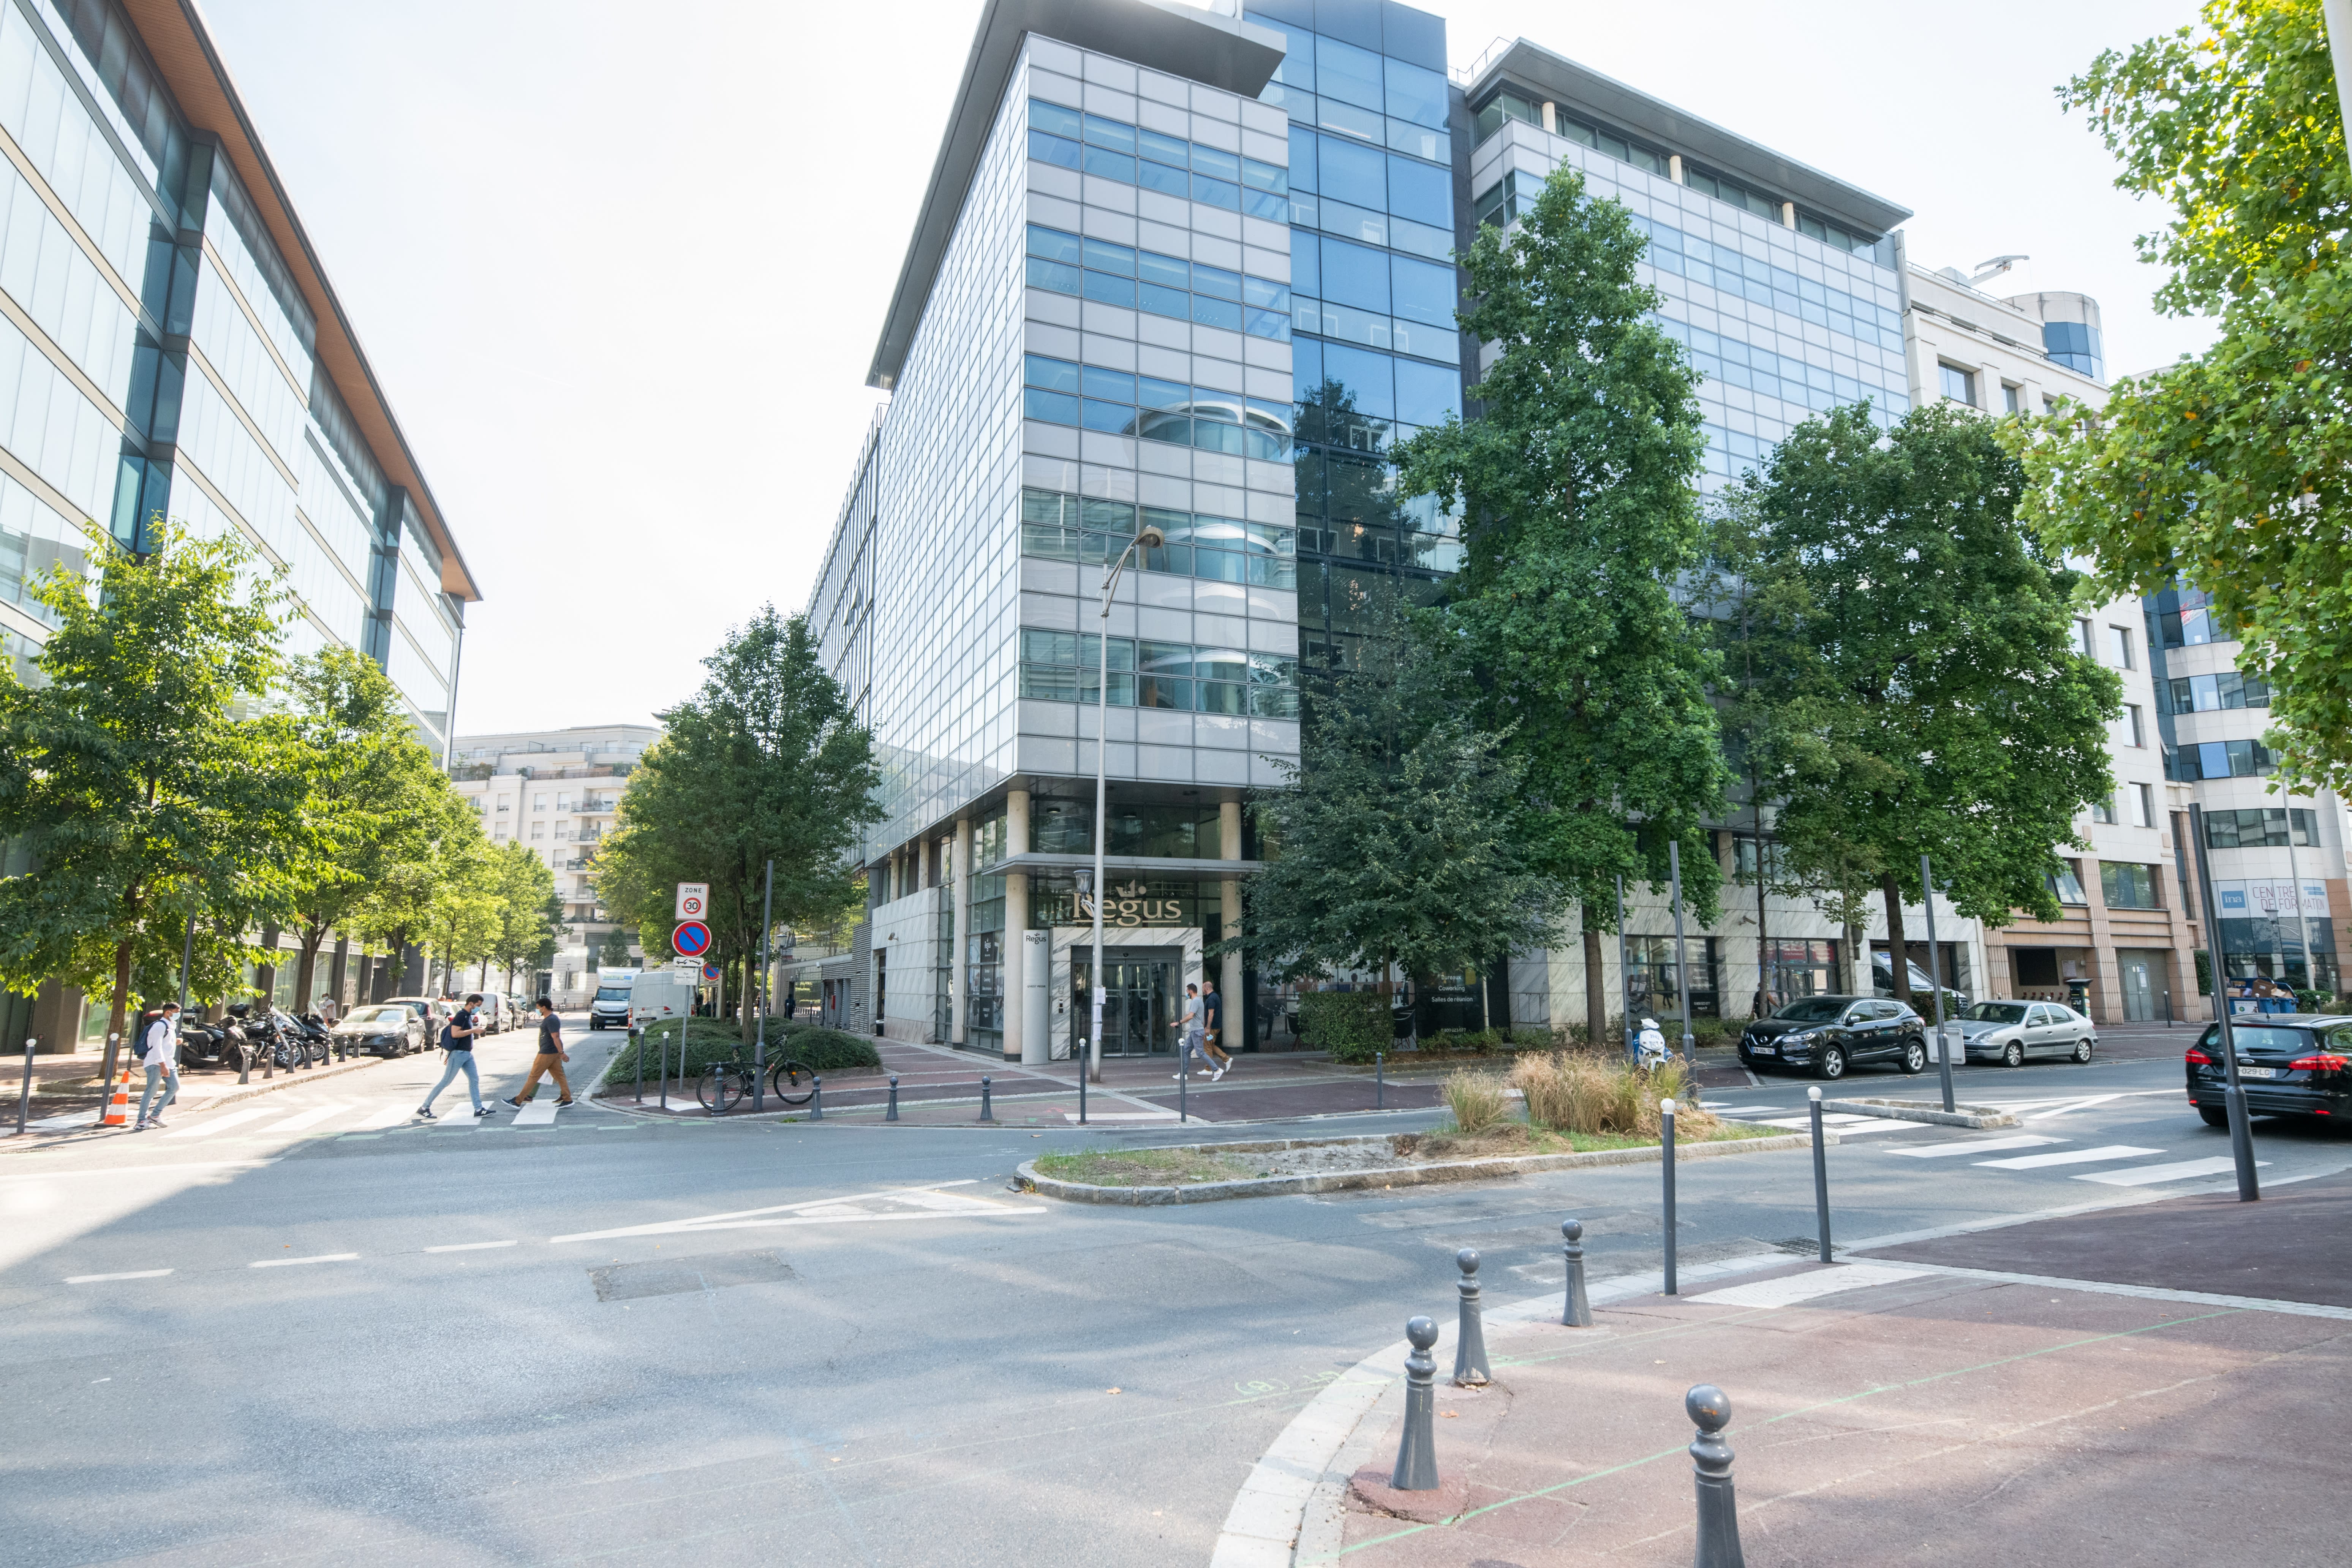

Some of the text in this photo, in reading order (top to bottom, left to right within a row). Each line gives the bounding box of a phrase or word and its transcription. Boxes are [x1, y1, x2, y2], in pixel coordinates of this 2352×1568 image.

[2252, 886, 2295, 898] CENTRE
[1073, 893, 1181, 926] Regus
[2260, 899, 2275, 910] DE
[1026, 935, 1046, 944] Regus
[1691, 945, 1707, 954] Regus
